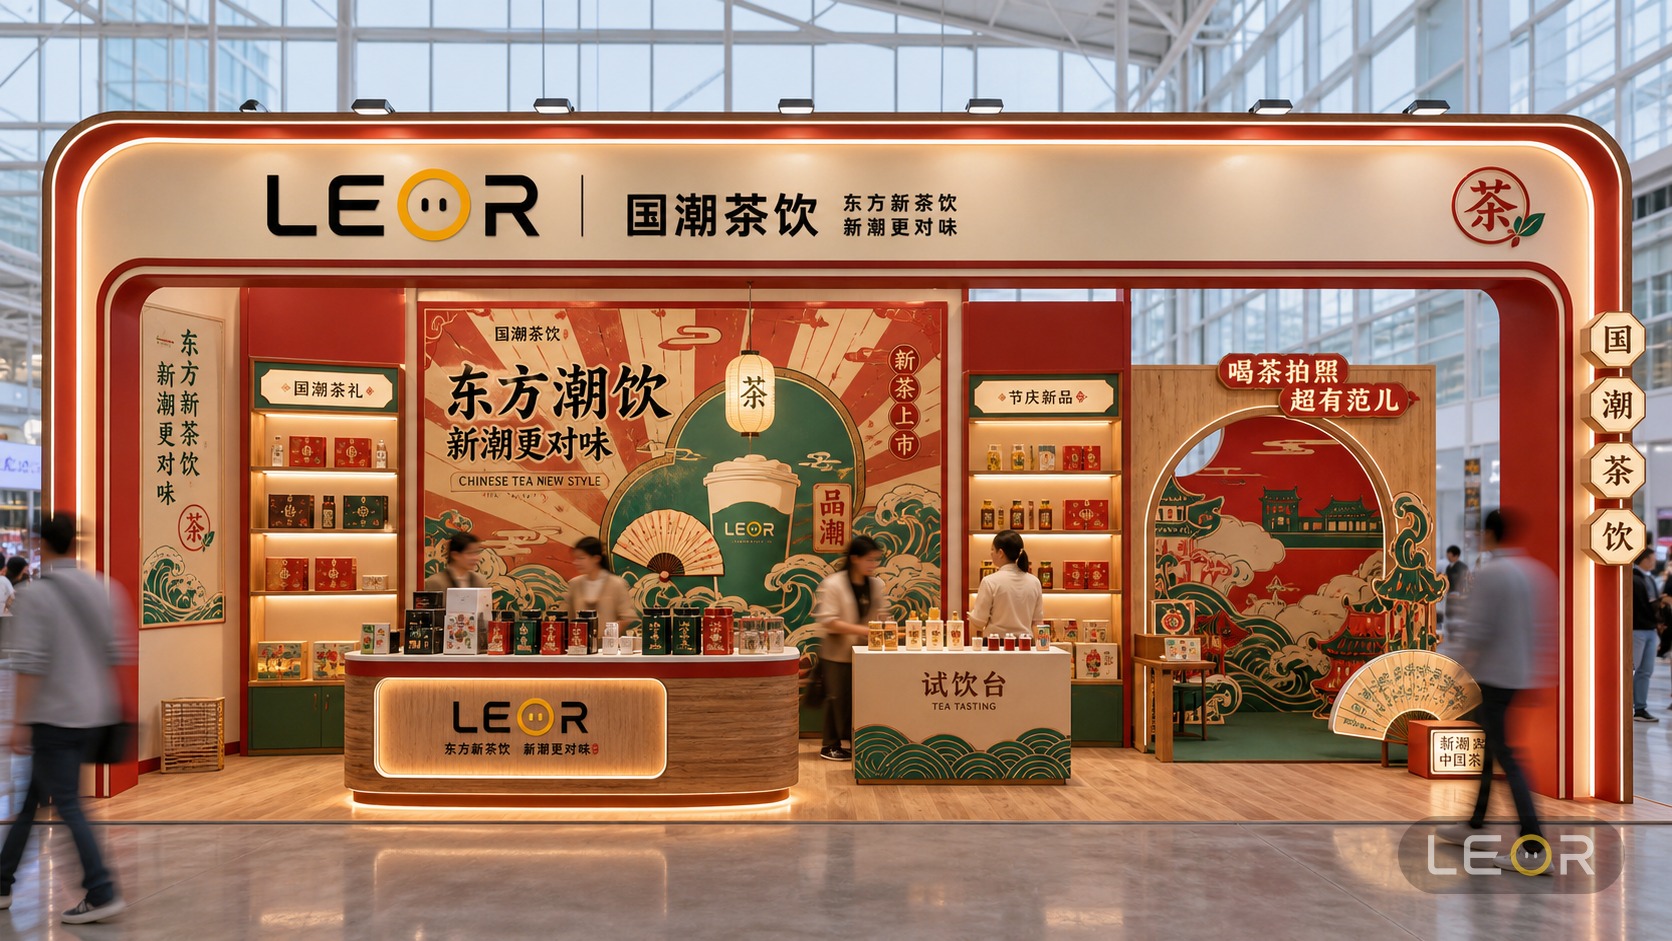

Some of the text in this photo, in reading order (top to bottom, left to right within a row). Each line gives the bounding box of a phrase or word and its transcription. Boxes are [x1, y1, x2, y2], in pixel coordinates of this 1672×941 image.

[267, 168, 540, 241] LEOR
[627, 193, 818, 237] 国潮茶饮
[843, 193, 957, 212] 东方新茶饮
[1464, 179, 1518, 232] 茶
[843, 217, 957, 236] 新潮更对味
[495, 326, 561, 342] 国潮茶饮
[1228, 359, 1338, 384] 喝茶拍照
[180, 329, 200, 477] 东方新茶饮
[294, 380, 363, 399] 国潮茶礼
[447, 363, 673, 420] 东方潮饮
[741, 375, 768, 409] 茶
[895, 350, 916, 455] 新茶上市
[1009, 390, 1073, 405] 节庆新品
[1290, 388, 1400, 412] 超有范儿
[157, 361, 176, 506] 新潮更对味
[446, 426, 613, 461] 新潮更对味
[1602, 325, 1634, 552] 国潮茶饮
[459, 476, 508, 486] CHINESE
[512, 476, 533, 486] TEA
[568, 476, 600, 486] STYLE
[184, 512, 205, 543] 茶
[725, 521, 775, 537] LEOR
[820, 489, 845, 546] 品潮
[922, 671, 1006, 698] 试饮台
[453, 698, 588, 737] LEOR
[932, 702, 997, 711] TEA TASTING
[444, 742, 591, 755] 东方新茶饮 新潮更对味
